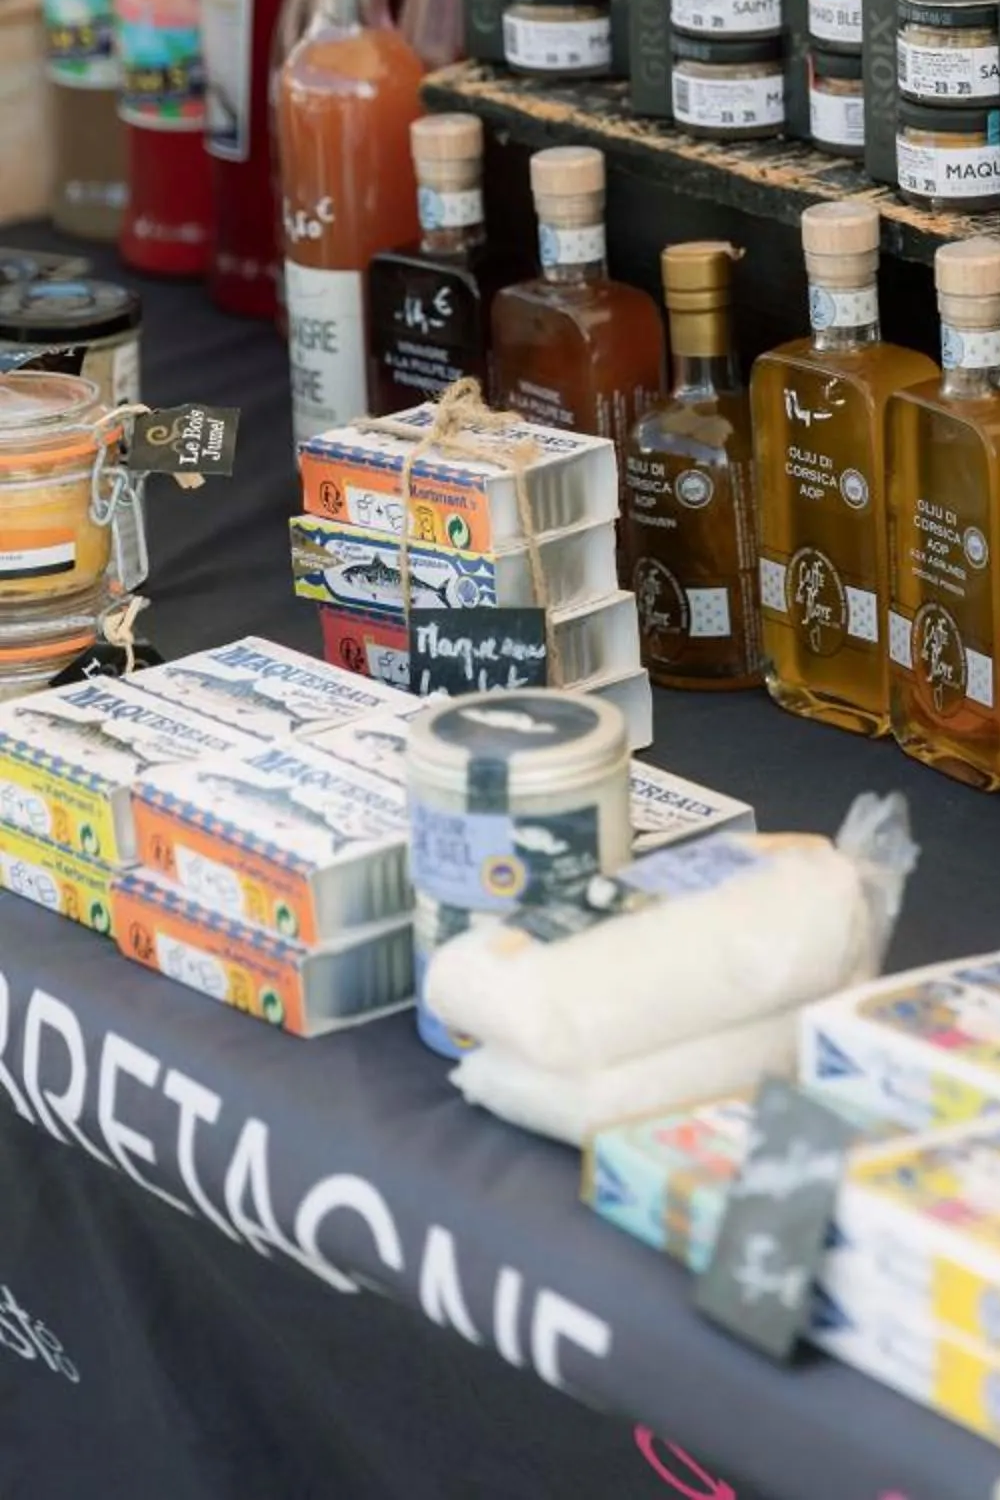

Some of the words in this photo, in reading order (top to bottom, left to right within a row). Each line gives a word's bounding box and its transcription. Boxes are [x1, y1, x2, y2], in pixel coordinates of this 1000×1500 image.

[837, 9, 862, 26] BLE
[868, 8, 896, 124] ROIX
[181, 408, 205, 441] Bois
[179, 441, 198, 465] Le
[785, 461, 839, 488] CORSICA
[915, 499, 943, 520] OLIU
[913, 515, 961, 545] CORSICA
[210, 646, 392, 709] MAQUEREAUX
[59, 686, 238, 752] MAQUEREAUX
[242, 748, 407, 817] MAQUEREA
[628, 776, 722, 818] EREAUX
